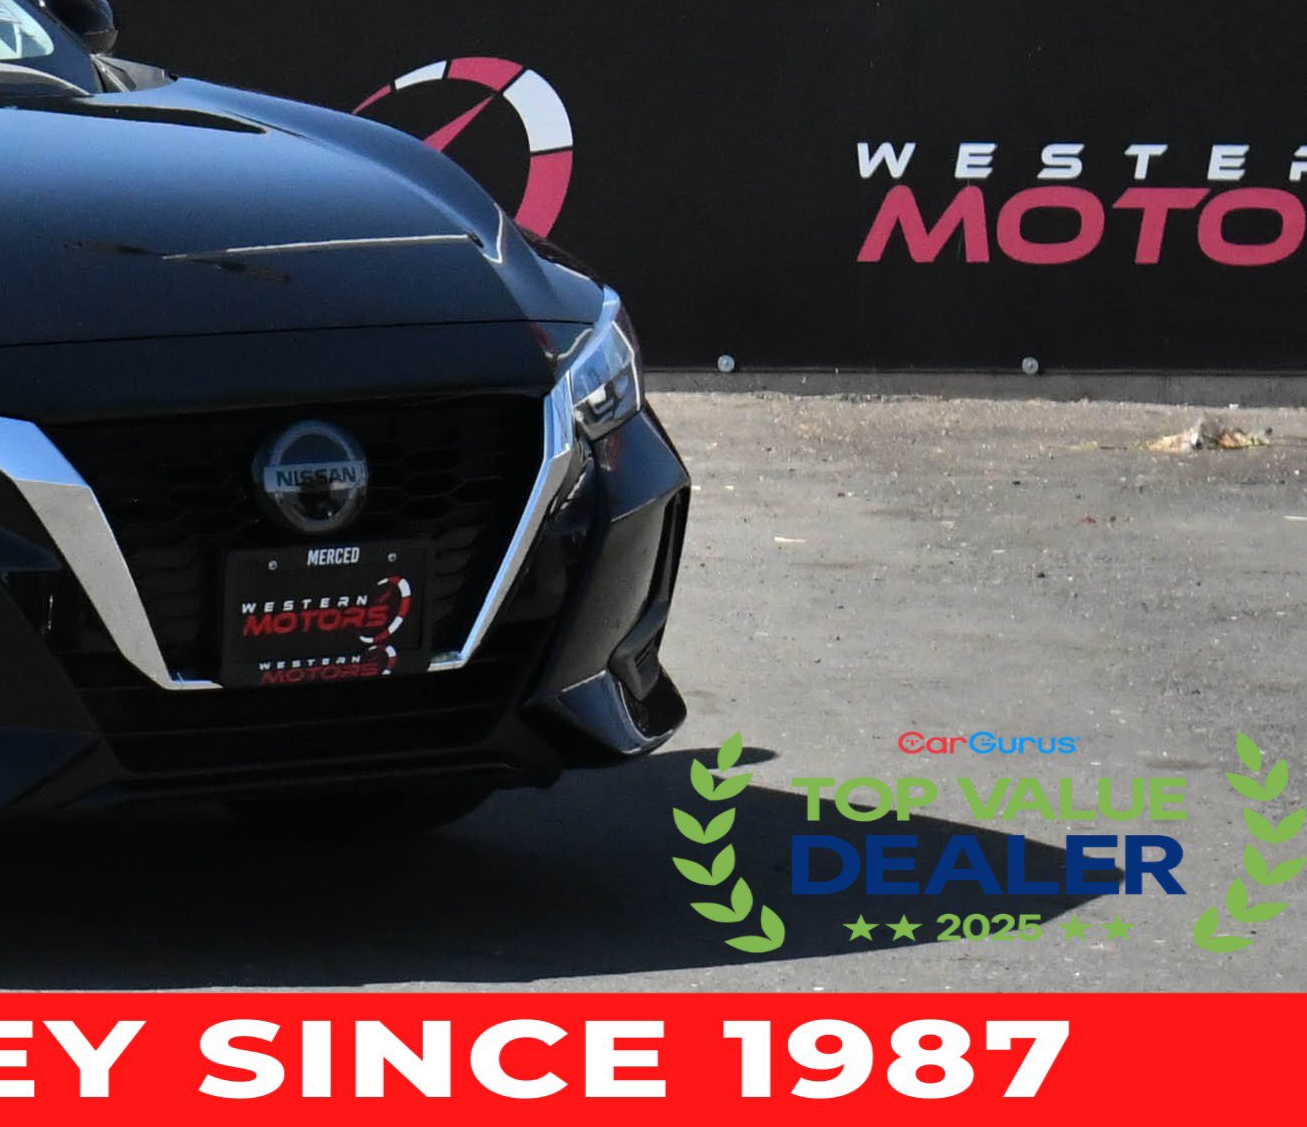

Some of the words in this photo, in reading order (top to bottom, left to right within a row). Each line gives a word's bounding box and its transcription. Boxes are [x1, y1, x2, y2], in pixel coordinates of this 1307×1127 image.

[857, 186, 1305, 265] MOTO
[276, 467, 356, 487] NISSAN
[307, 547, 360, 566] MERCED
[241, 594, 368, 615] WESTERN
[242, 604, 390, 637] MOTORS
[258, 655, 363, 671] WESTERN
[260, 662, 380, 684] MOTORS
